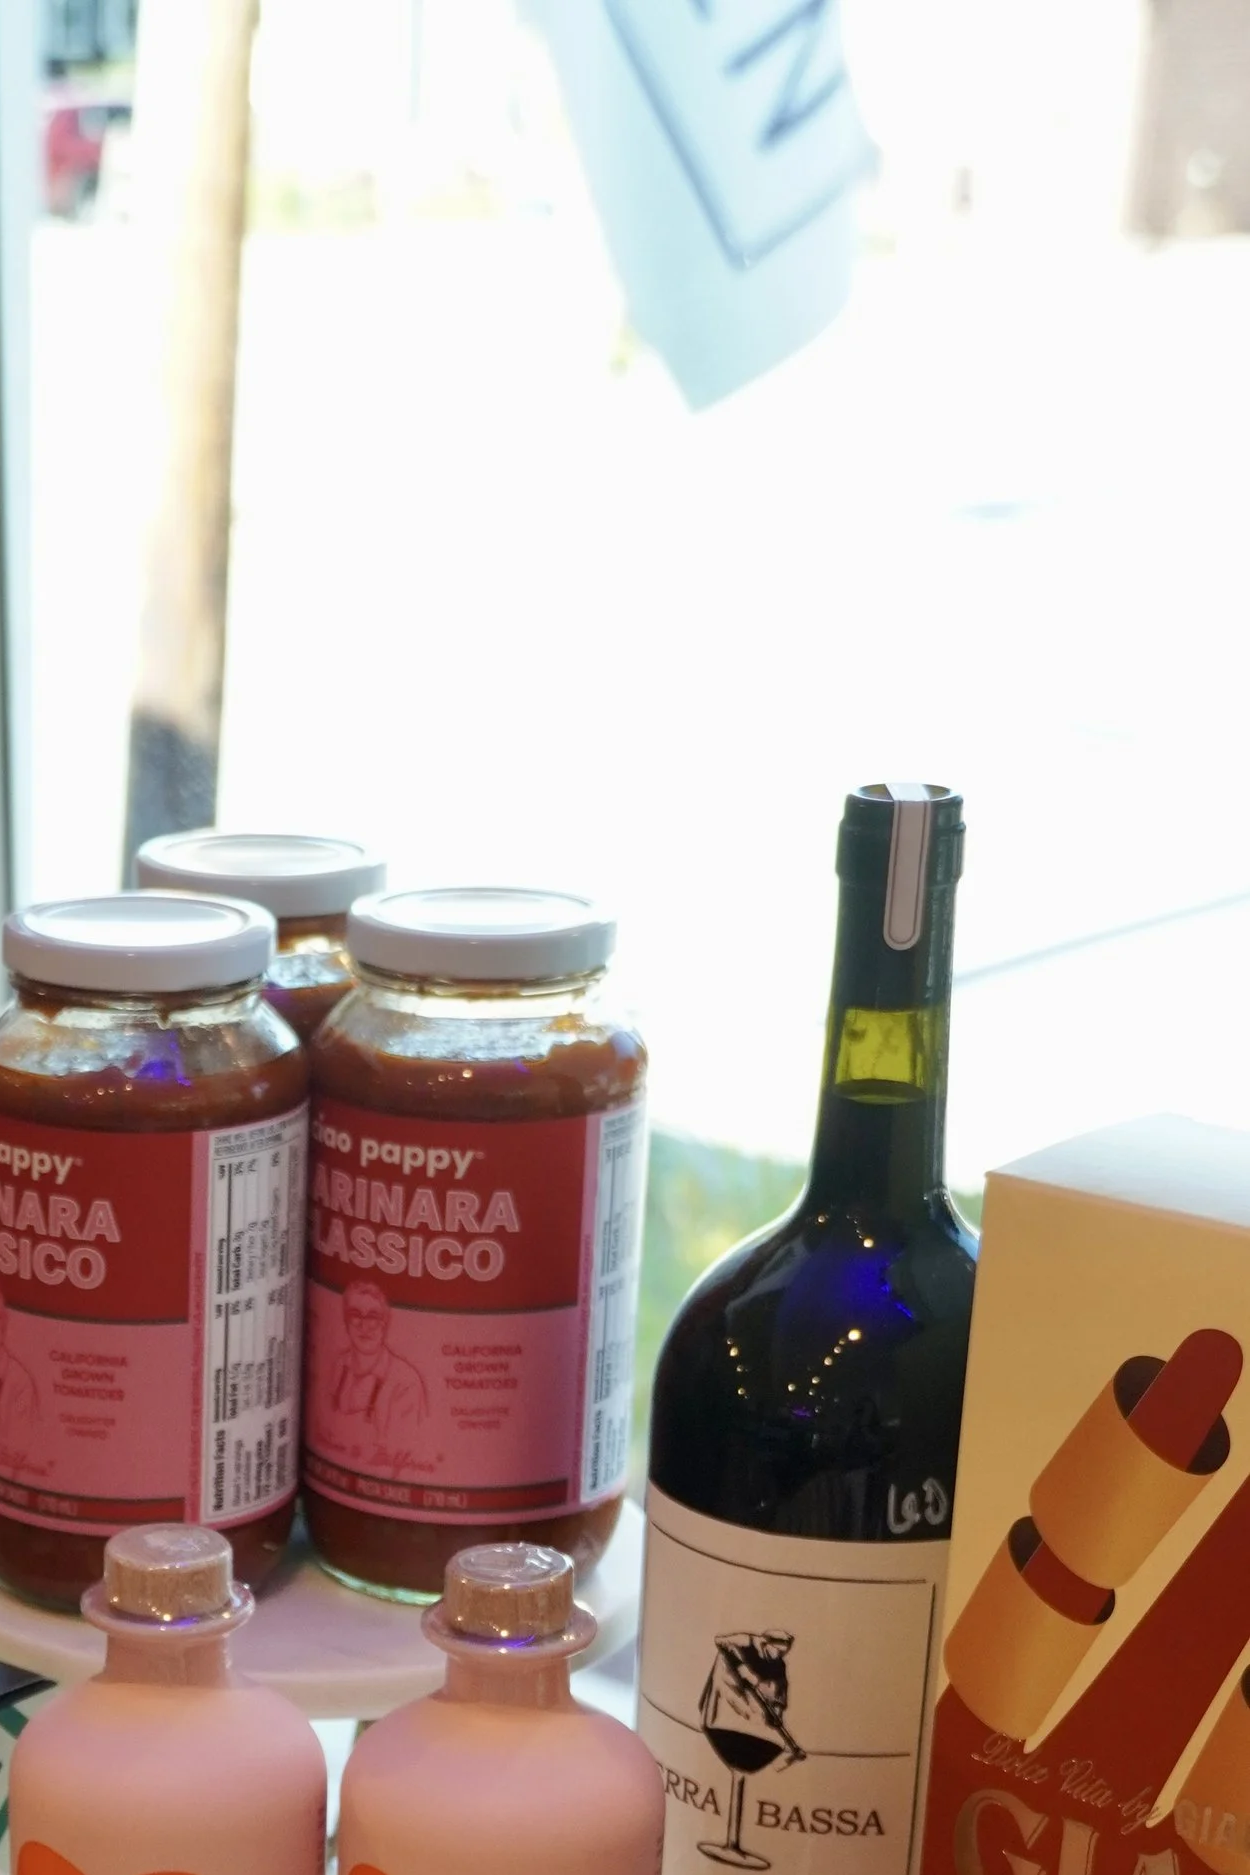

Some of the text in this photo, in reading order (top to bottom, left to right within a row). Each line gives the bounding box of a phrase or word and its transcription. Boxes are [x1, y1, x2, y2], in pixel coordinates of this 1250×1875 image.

[360, 1137, 475, 1180] pappy
[313, 1163, 521, 1234] ARINARA
[313, 1209, 505, 1282] LASSICO
[657, 1760, 886, 1837] RRA BASSA
